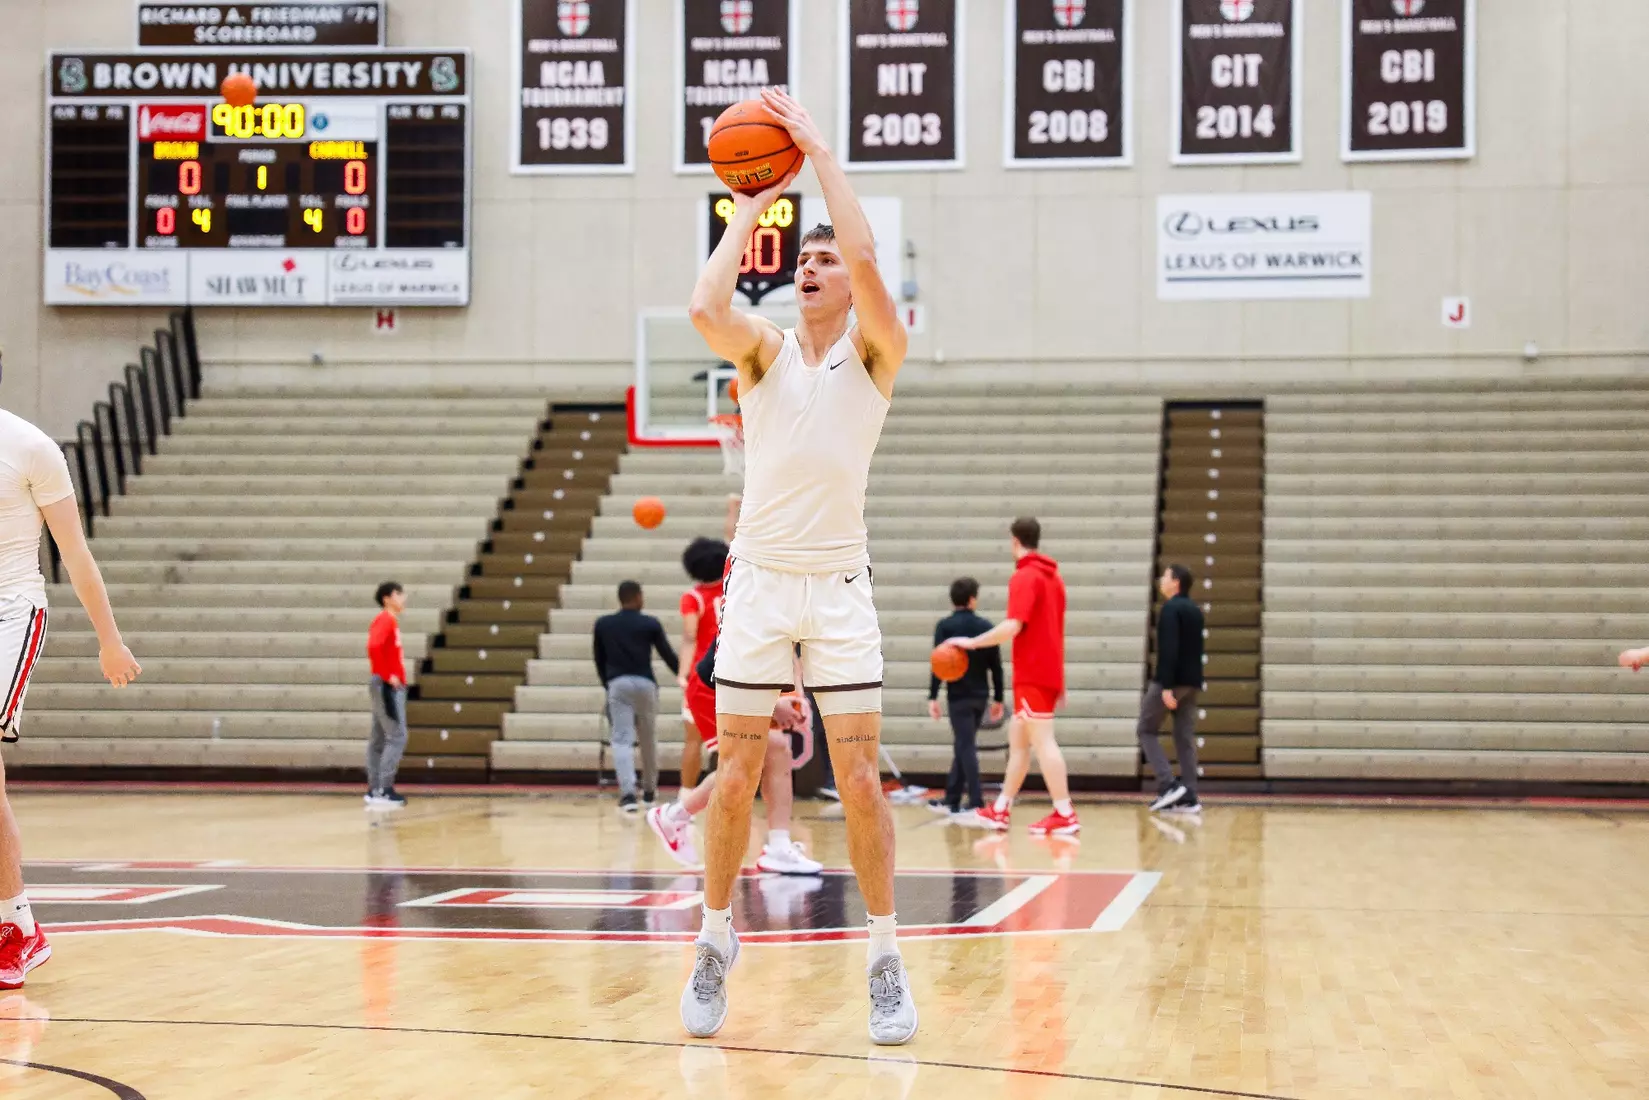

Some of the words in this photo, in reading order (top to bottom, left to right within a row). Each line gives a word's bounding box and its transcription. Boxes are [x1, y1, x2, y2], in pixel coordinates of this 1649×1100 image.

[140, 7, 221, 24] RICHARD
[251, 6, 343, 23] FRIEDMAN
[194, 25, 317, 43] SCOREBOARD
[93, 62, 216, 89] BROWN
[541, 60, 605, 87] NCAA
[704, 58, 769, 85] NCAA
[877, 62, 927, 96] NIT
[1043, 59, 1095, 93] CBI
[1211, 53, 1263, 88] CIT
[1381, 48, 1435, 83] CBI
[212, 103, 305, 139] 90:00
[862, 112, 941, 146] 2003
[1028, 109, 1108, 143] 2008
[1196, 104, 1275, 139] 2014
[1367, 99, 1447, 135] 2019
[537, 117, 608, 150] 1939
[179, 160, 201, 195] 0
[257, 165, 267, 190] 1
[344, 160, 366, 195] 0
[156, 207, 175, 234] 0
[192, 208, 211, 233] 4
[303, 208, 323, 233] 4
[346, 207, 366, 234] 0
[1208, 216, 1320, 233] LEXUS
[1165, 254, 1226, 270] LEXUS
[1232, 253, 1256, 269] OF
[1265, 251, 1363, 268] WARWICK
[206, 276, 306, 296] SHAWMUT
[376, 309, 395, 329] H
[1448, 303, 1465, 323] J
